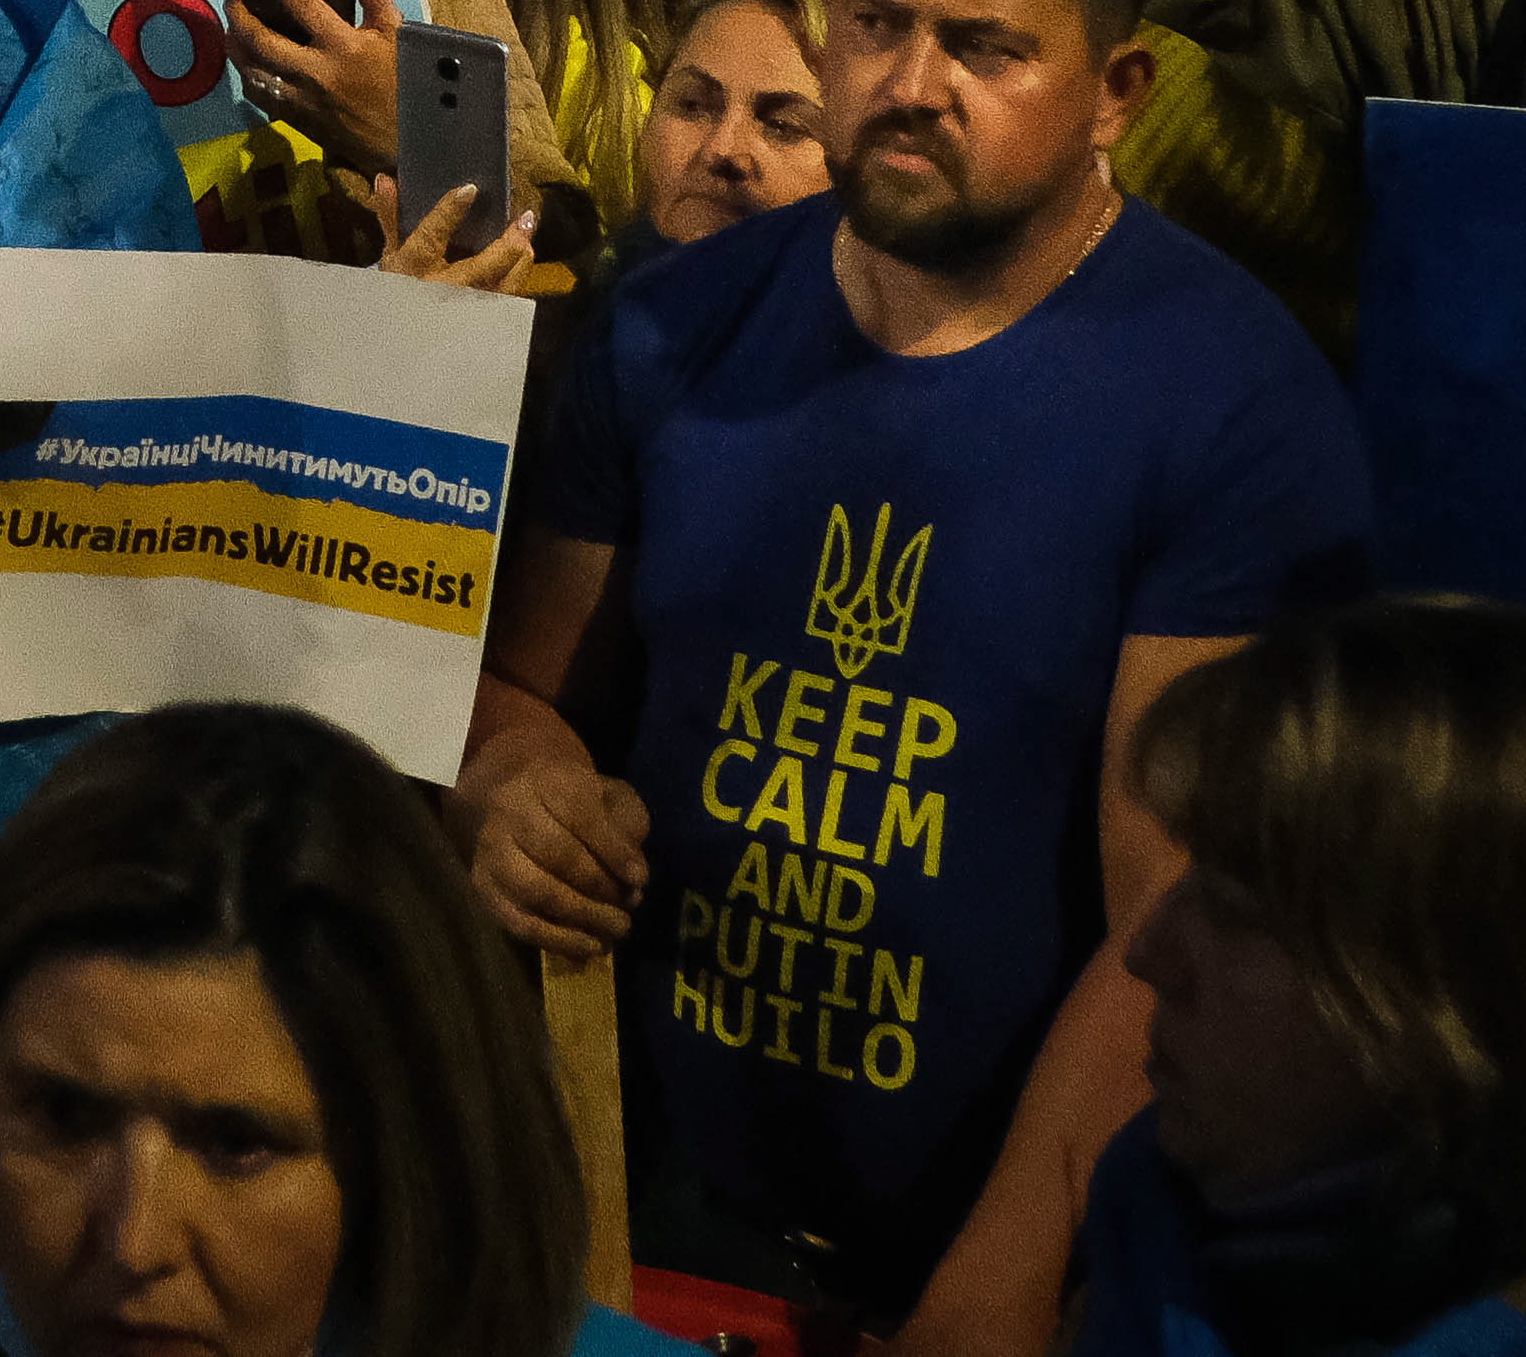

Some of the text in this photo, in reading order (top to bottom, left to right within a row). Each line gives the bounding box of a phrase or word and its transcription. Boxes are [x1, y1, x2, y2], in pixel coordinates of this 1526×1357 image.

[717, 651, 958, 780] KEEP
[701, 738, 947, 879] CALM
[726, 841, 875, 934] AND
[678, 888, 926, 1024] PUTIN
[672, 969, 916, 1092] HUILO
